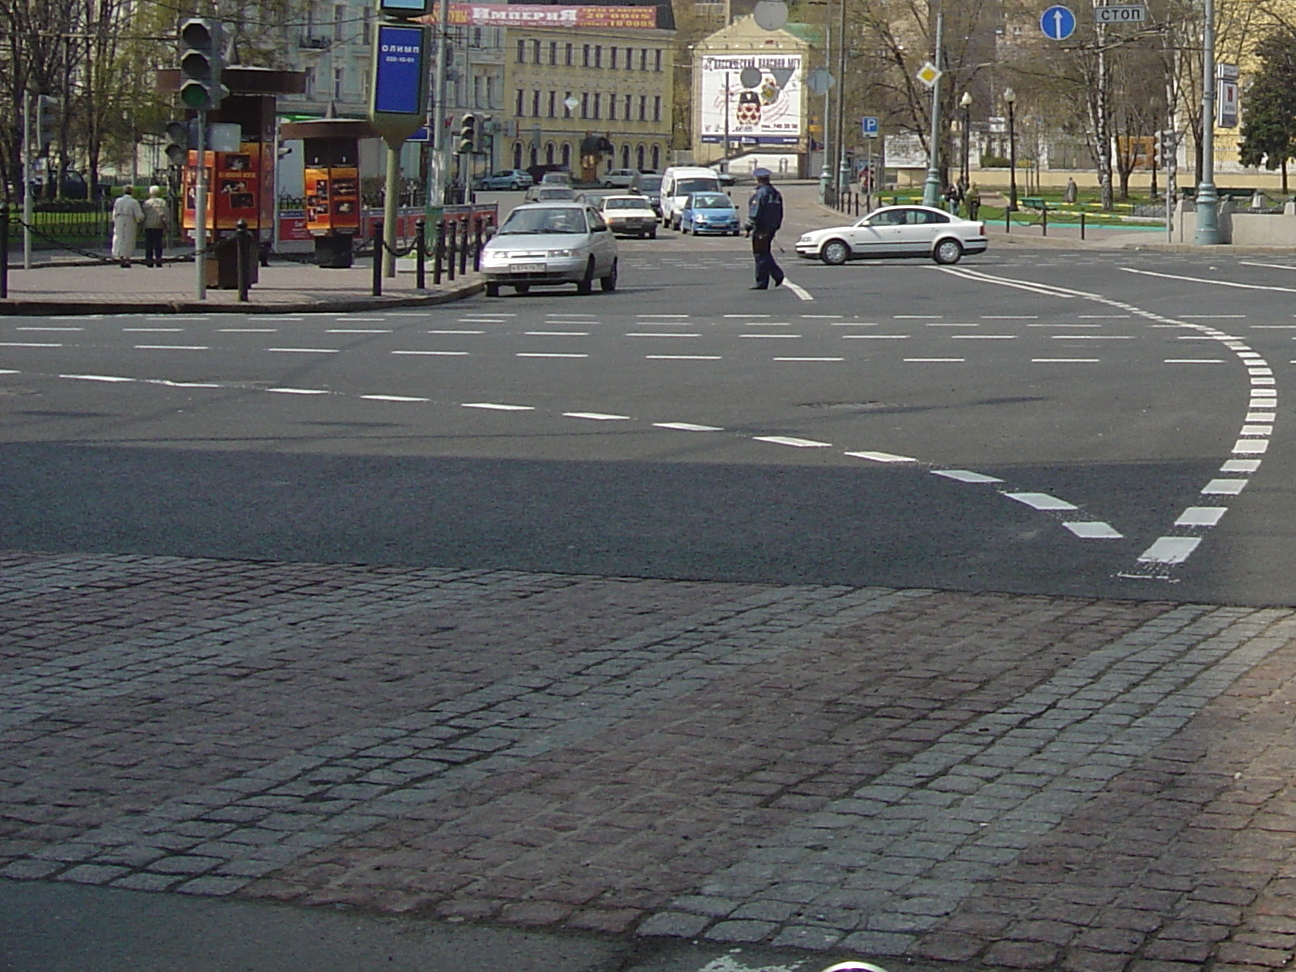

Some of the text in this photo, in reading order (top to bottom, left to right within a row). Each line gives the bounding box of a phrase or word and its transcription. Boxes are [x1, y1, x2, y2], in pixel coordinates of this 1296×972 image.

[1101, 8, 1140, 21] СТОП
[381, 44, 420, 53] ОЛИМП
[867, 118, 876, 130] P
